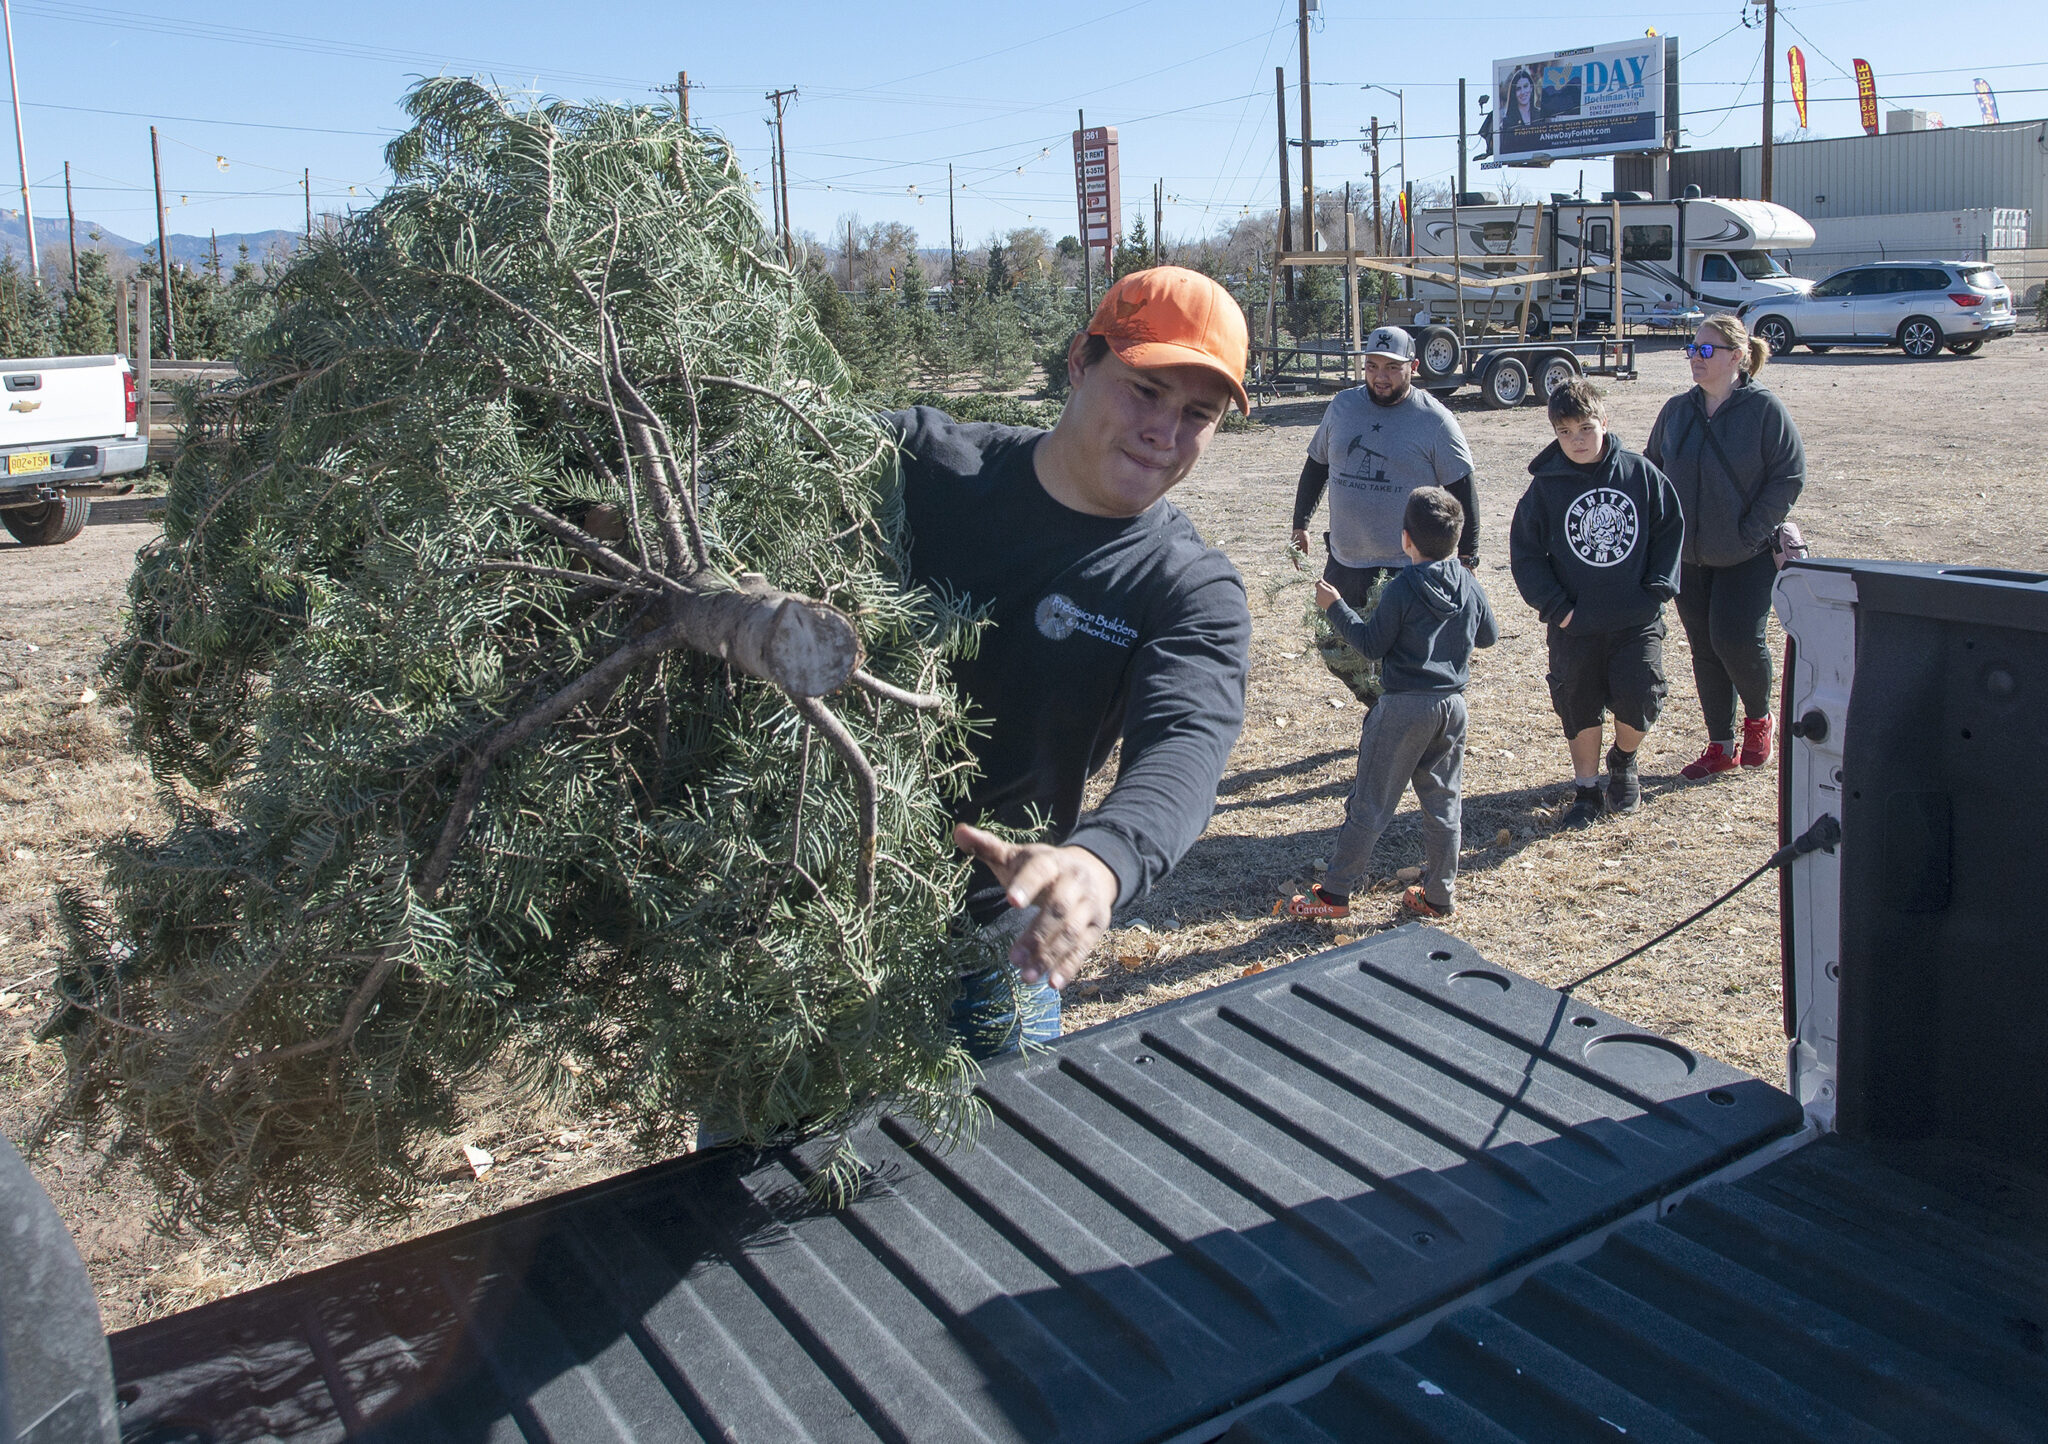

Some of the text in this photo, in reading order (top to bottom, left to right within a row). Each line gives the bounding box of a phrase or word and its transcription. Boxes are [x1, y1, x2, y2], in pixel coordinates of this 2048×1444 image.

[1584, 55, 1650, 95] DAY
[1856, 63, 1872, 96] FREE
[1584, 88, 1645, 103] Hochman-Vigil
[1603, 101, 1640, 110] REPRESENTATIVE
[1514, 115, 1638, 136] FIGHTING FOR OUR NORTH VALLEY
[1083, 130, 1099, 140] 561
[1540, 127, 1611, 141] ANewDayForNM.com
[1077, 150, 1104, 160] FR RENT
[1488, 240, 1508, 249] Jayc
[11, 455, 49, 469] 802 TSM
[1347, 481, 1367, 490] AND
[1369, 483, 1393, 493] TAKE
[1571, 493, 1630, 518] WHITE
[1571, 526, 1634, 563] ZOMBIE
[1052, 596, 1139, 639] Precision Builders
[1065, 617, 1074, 626] &
[1111, 633, 1131, 648] LLC
[1296, 904, 1334, 915] Carrots
